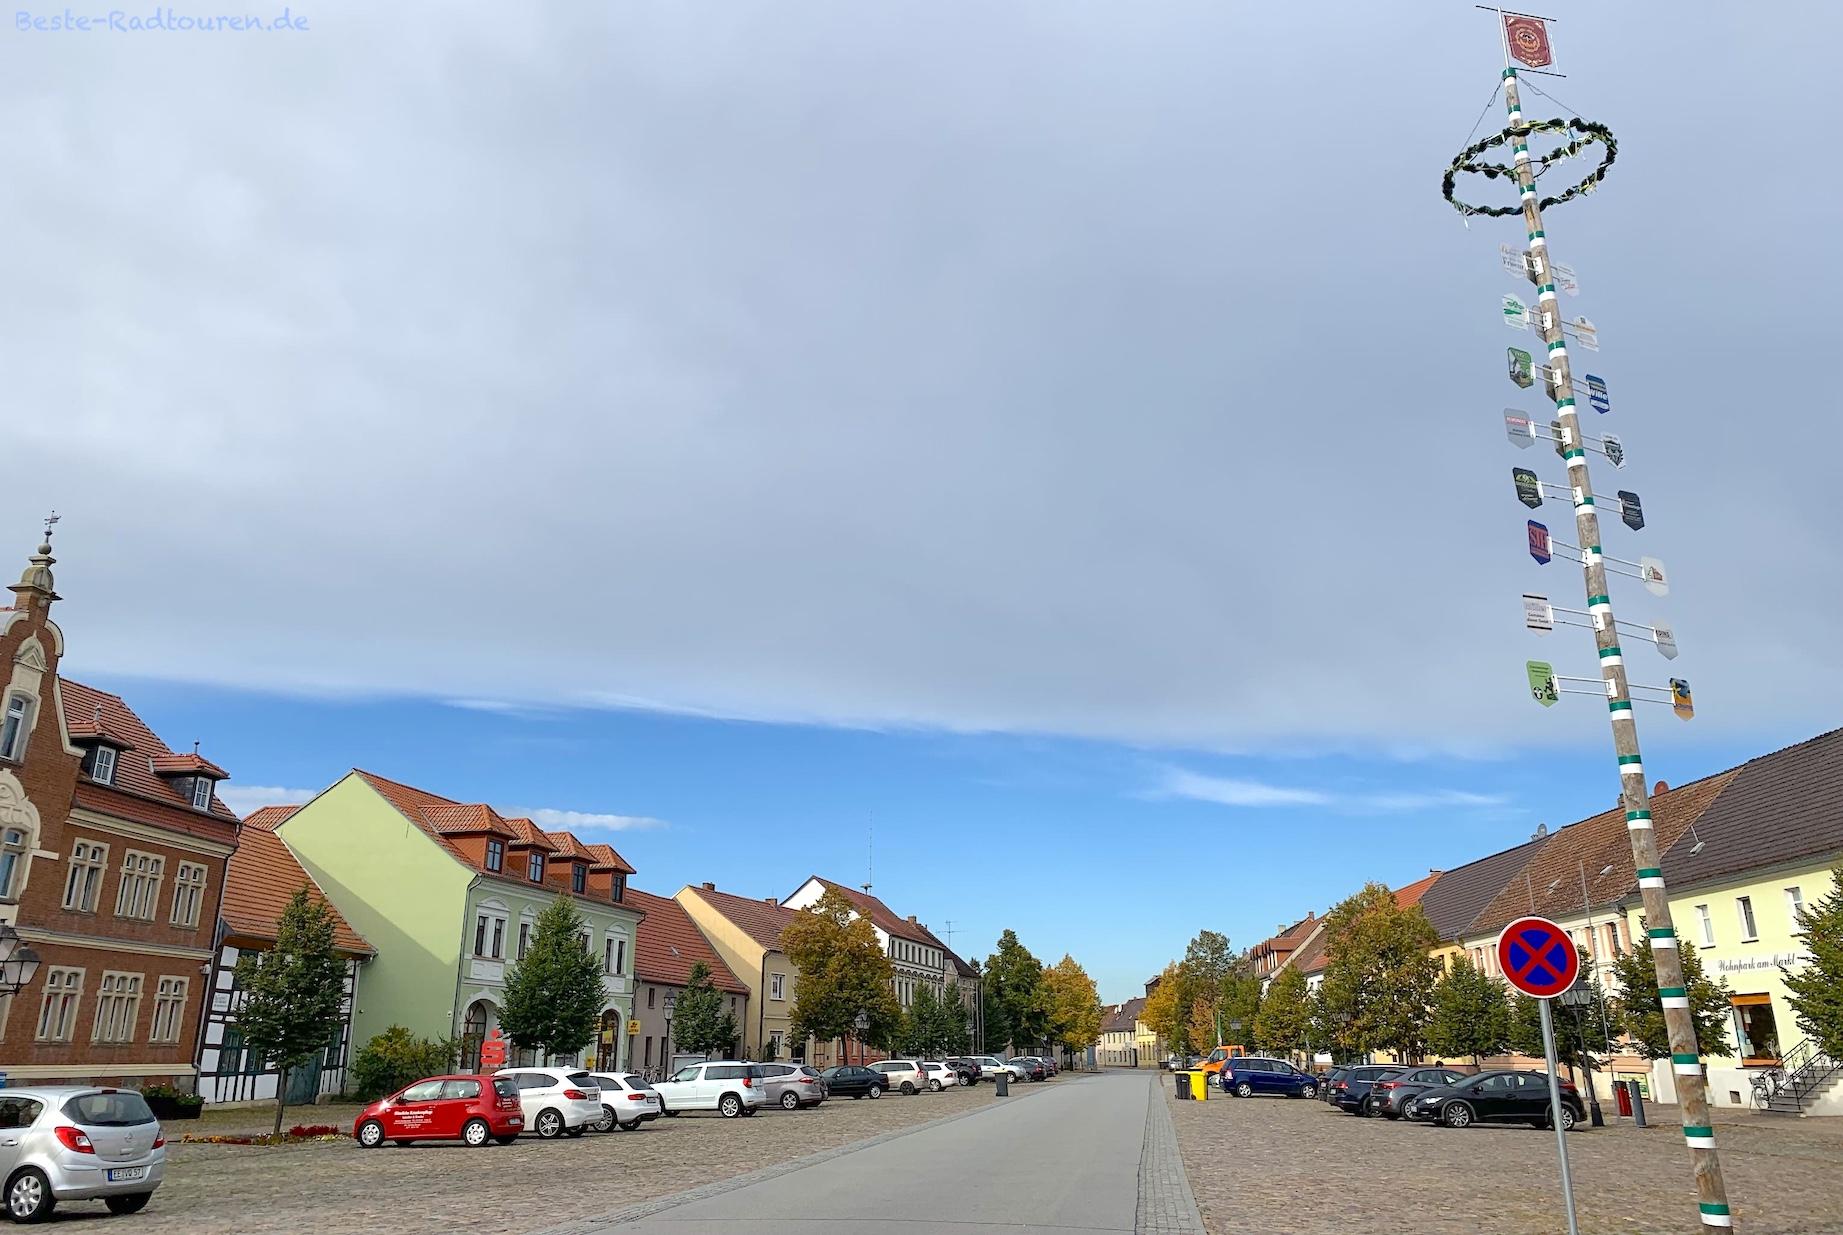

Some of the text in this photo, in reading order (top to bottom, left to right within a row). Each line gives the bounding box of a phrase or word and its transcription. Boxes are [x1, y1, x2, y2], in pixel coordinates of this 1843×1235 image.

[1718, 953, 1796, 973] Wohnpark am Markt
